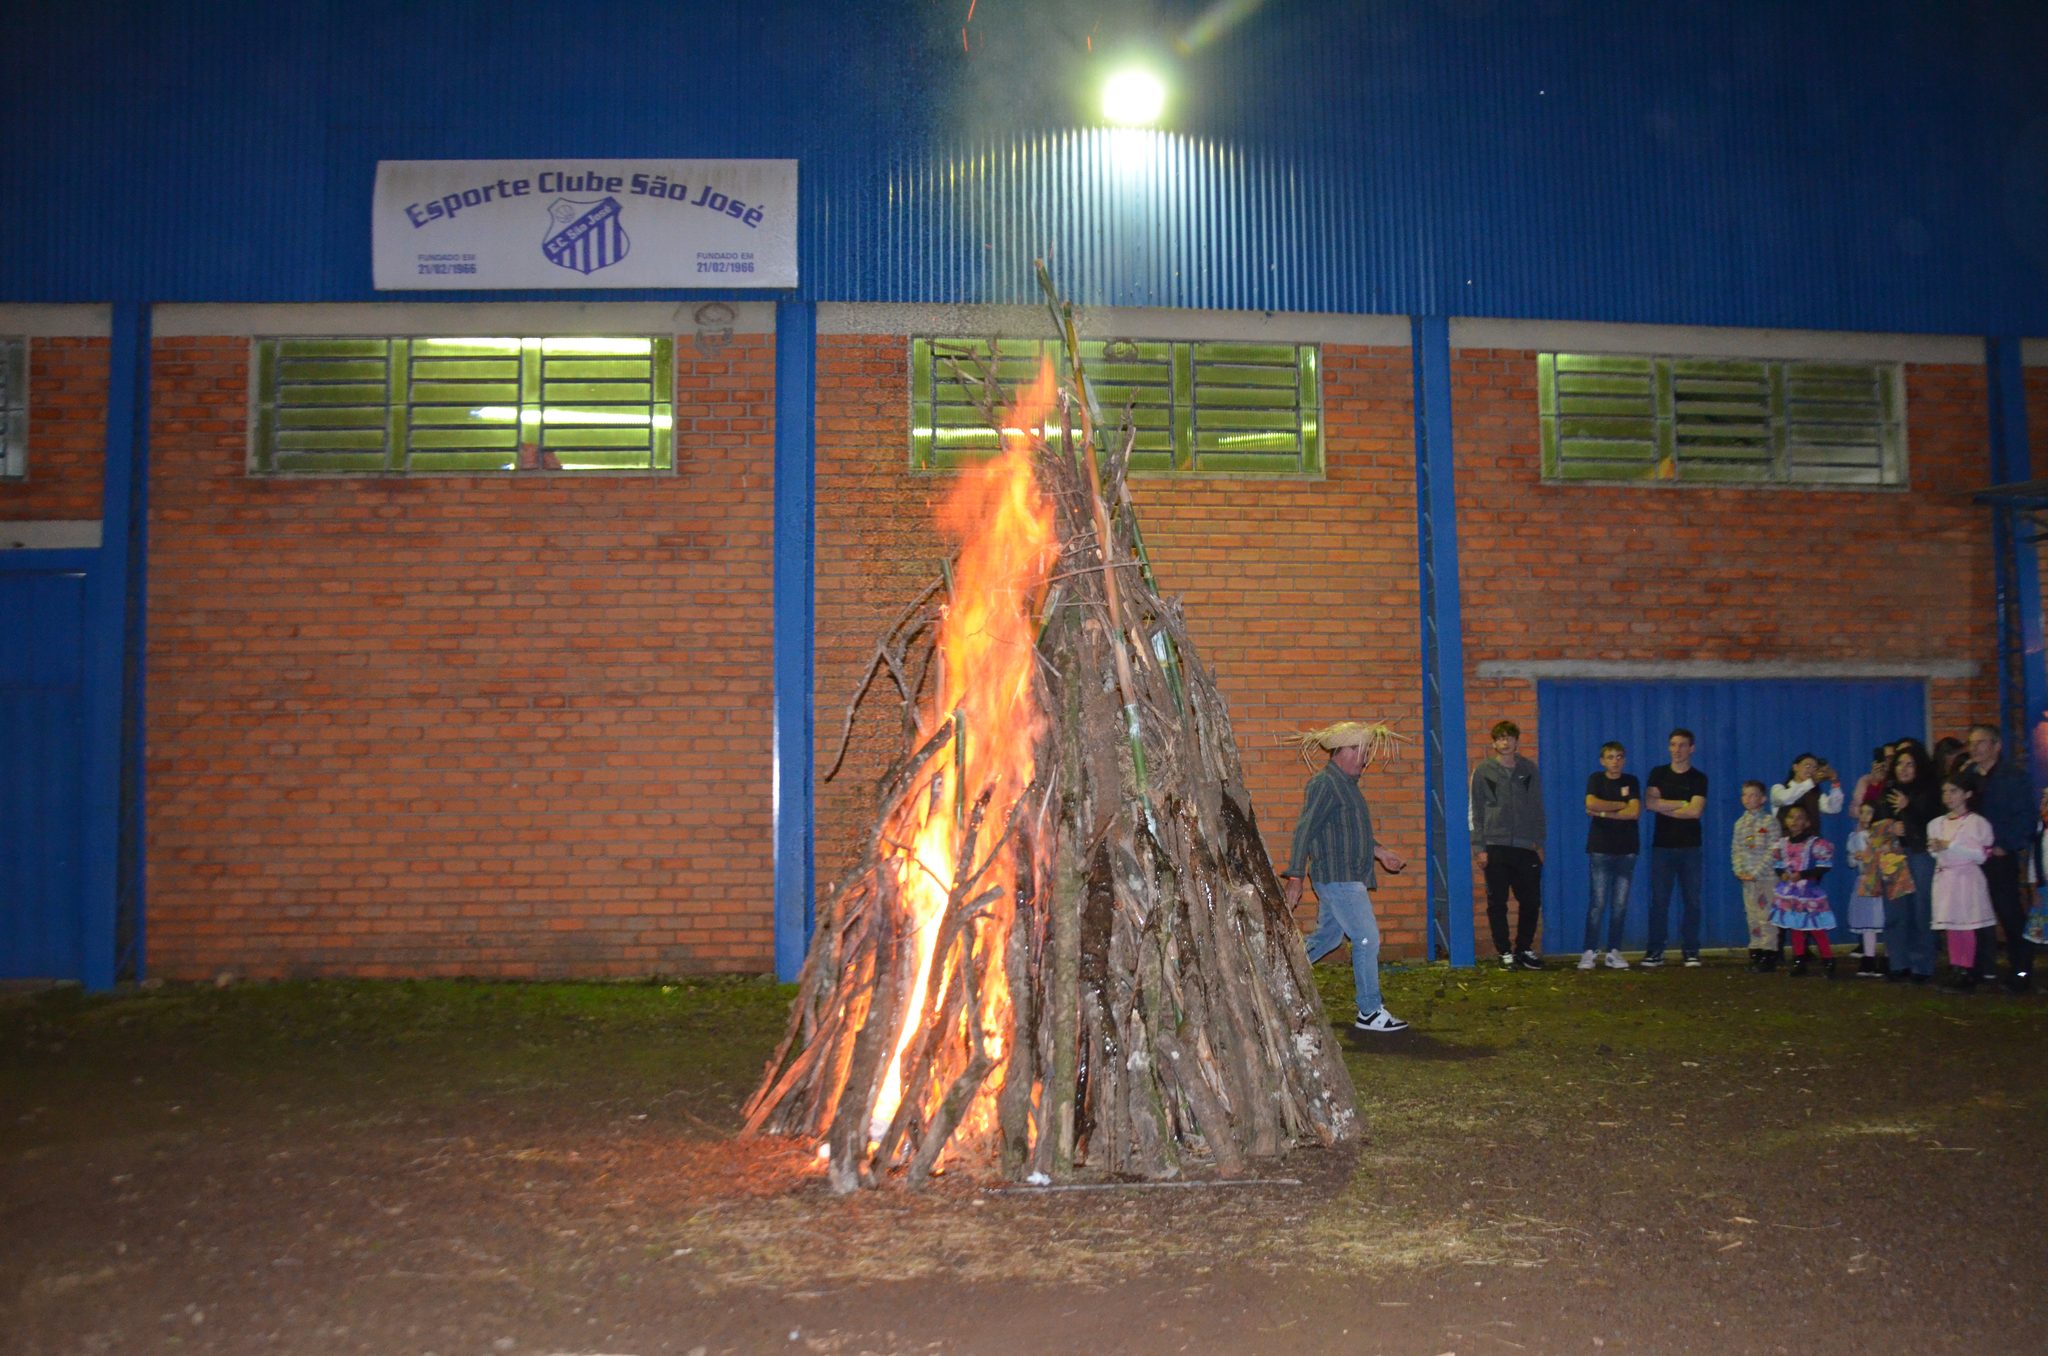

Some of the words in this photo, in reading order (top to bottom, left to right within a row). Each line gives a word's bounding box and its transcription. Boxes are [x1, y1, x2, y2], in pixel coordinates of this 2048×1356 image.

[404, 179, 530, 228] Esporte
[538, 171, 622, 193] Clube
[630, 173, 687, 202] São
[691, 186, 764, 228] José
[697, 252, 738, 260] FUNDADO
[741, 252, 754, 260] EM
[697, 262, 754, 273] 21/02/1966
